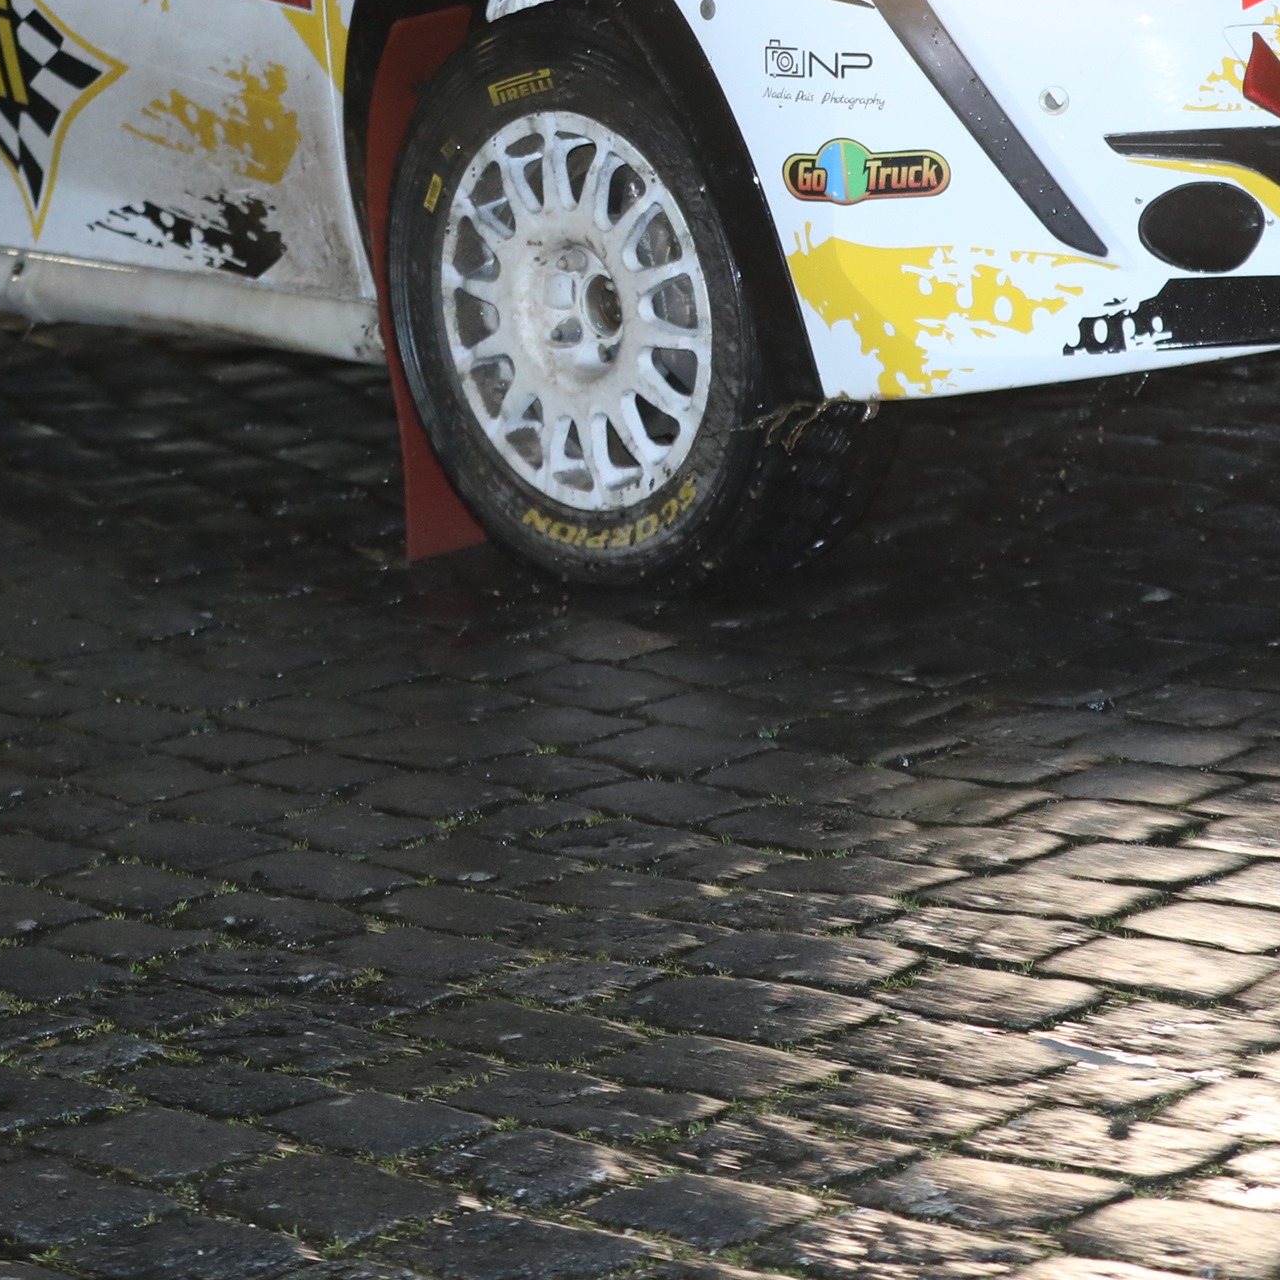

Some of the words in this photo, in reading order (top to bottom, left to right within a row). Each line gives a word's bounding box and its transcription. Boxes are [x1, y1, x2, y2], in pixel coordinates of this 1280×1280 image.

[808, 50, 874, 80] NP
[487, 67, 555, 108] PIRELLI
[762, 84, 793, 102] Nadia
[794, 89, 815, 103] Pais
[821, 91, 886, 111] Photography
[797, 161, 828, 192] Go
[864, 156, 940, 193] Truck
[521, 476, 698, 550] SCORPION
